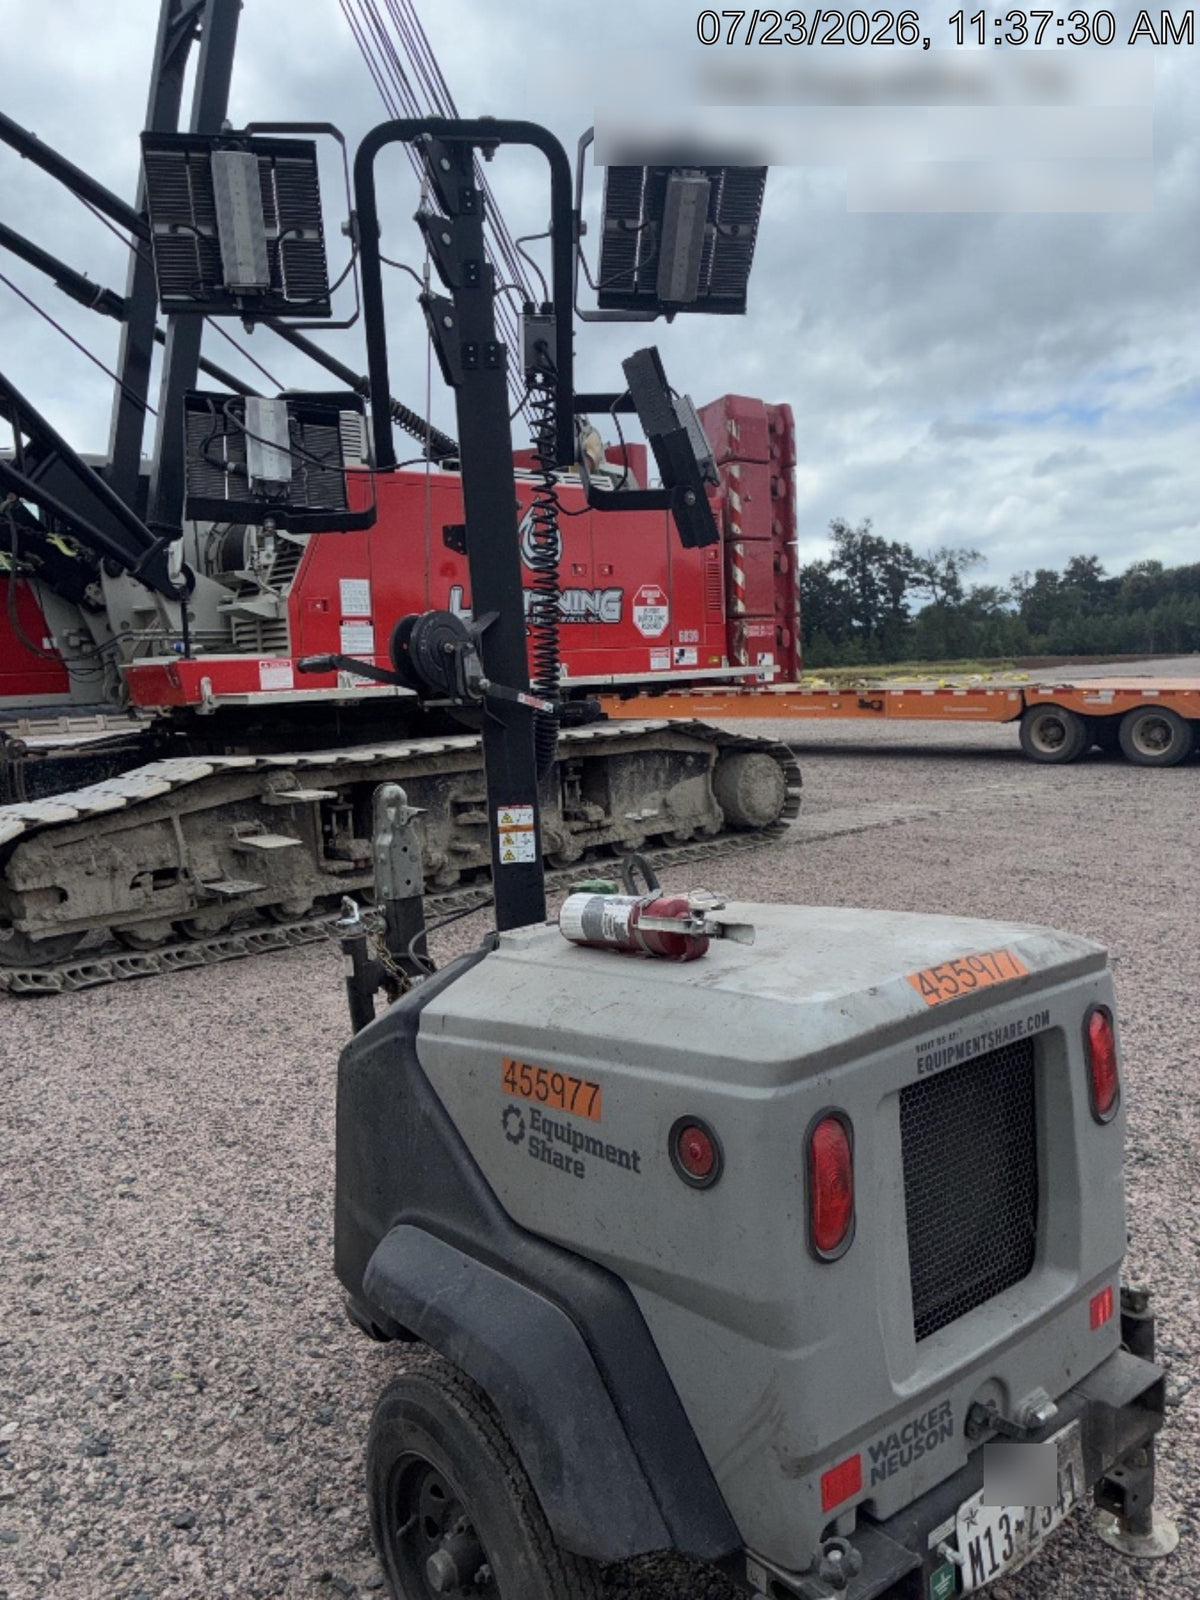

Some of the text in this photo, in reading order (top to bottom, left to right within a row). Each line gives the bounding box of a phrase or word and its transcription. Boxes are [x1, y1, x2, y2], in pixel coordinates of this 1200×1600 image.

[917, 949, 1020, 999] 455977
[917, 1009, 1050, 1075] EQUIPMENTSHARE.COM
[504, 1060, 600, 1117] 455977
[528, 1134, 586, 1180] Share
[529, 1107, 641, 1174] Equipment
[867, 1400, 953, 1464] WACKER
[870, 1418, 954, 1487] NEUSON
